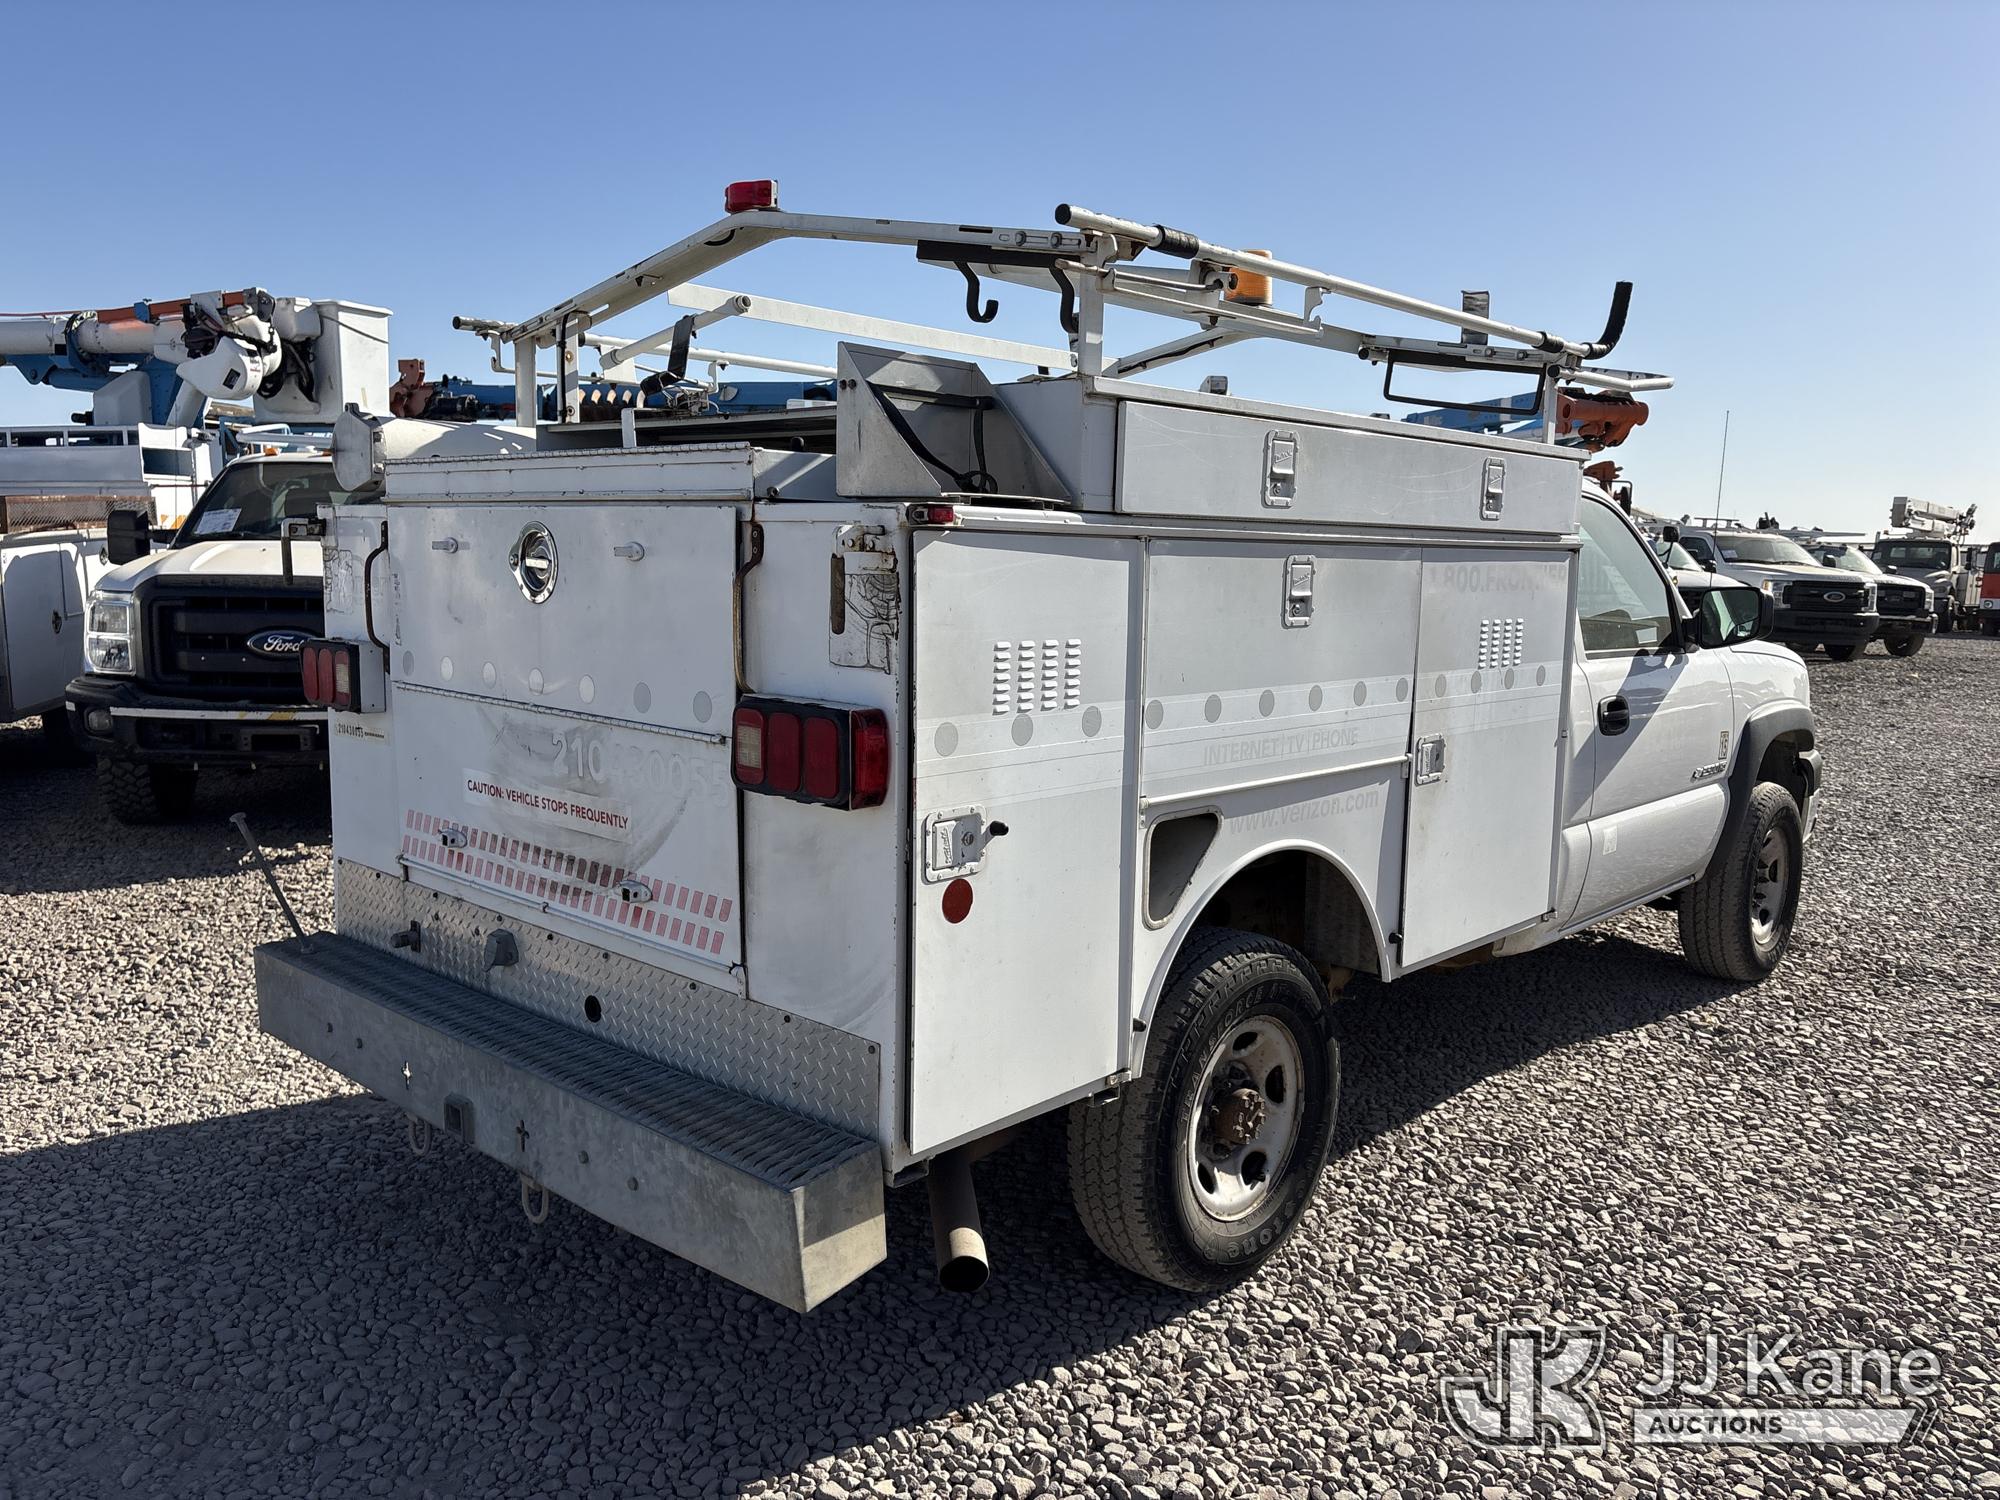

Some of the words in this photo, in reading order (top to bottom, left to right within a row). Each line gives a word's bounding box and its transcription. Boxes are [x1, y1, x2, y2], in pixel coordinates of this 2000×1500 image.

[263, 634, 305, 652] Ford
[467, 779, 505, 799] CAUTION:
[505, 788, 540, 808] VEHICLE
[541, 797, 569, 815] STOPS
[570, 804, 629, 830] FREQUENTLY
